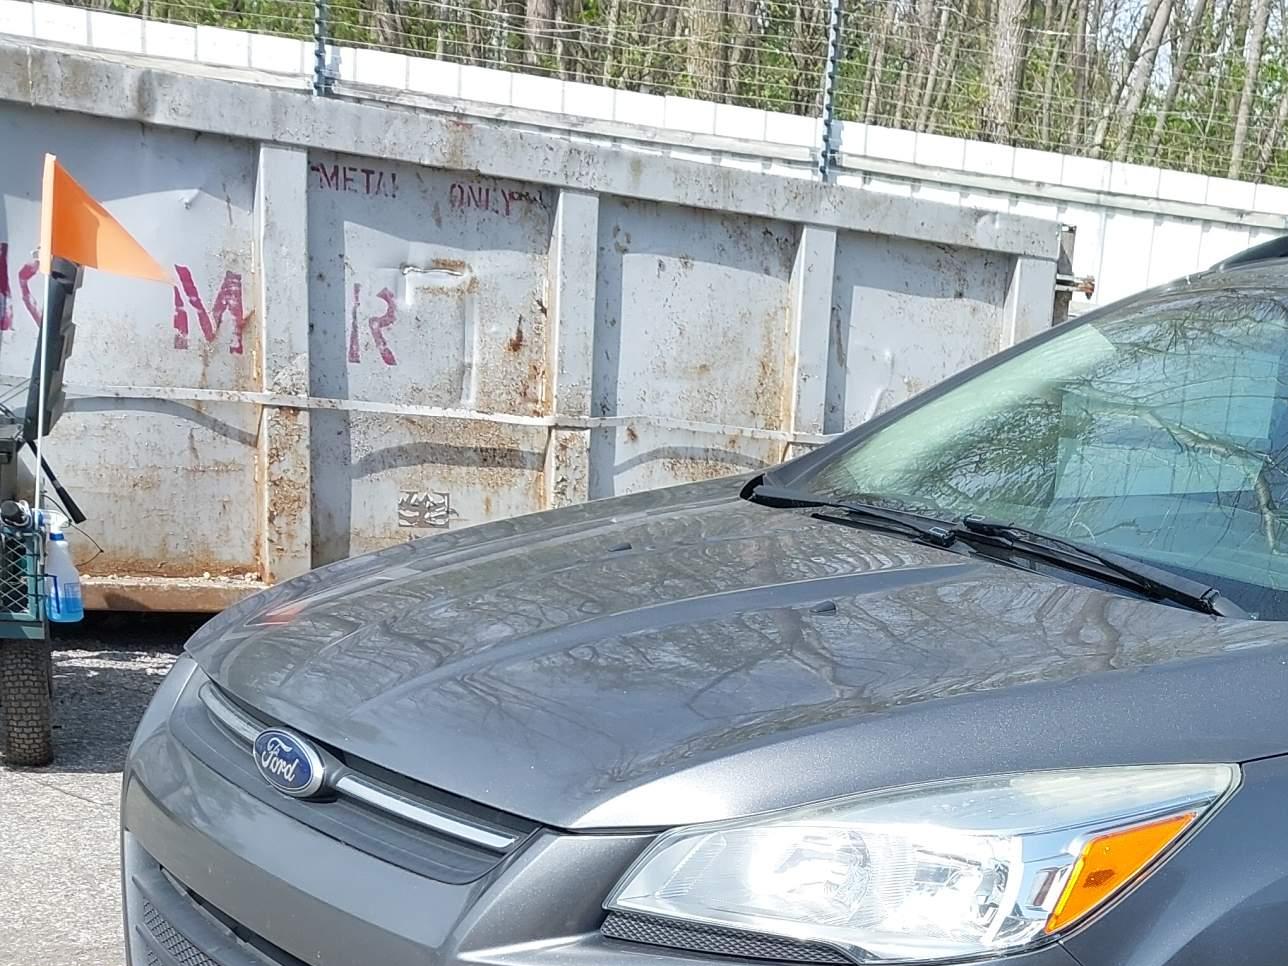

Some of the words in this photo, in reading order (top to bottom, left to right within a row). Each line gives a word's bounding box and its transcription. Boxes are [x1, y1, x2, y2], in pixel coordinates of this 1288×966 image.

[172, 263, 246, 356] M
[346, 282, 398, 367] R
[260, 736, 301, 783] Ford
